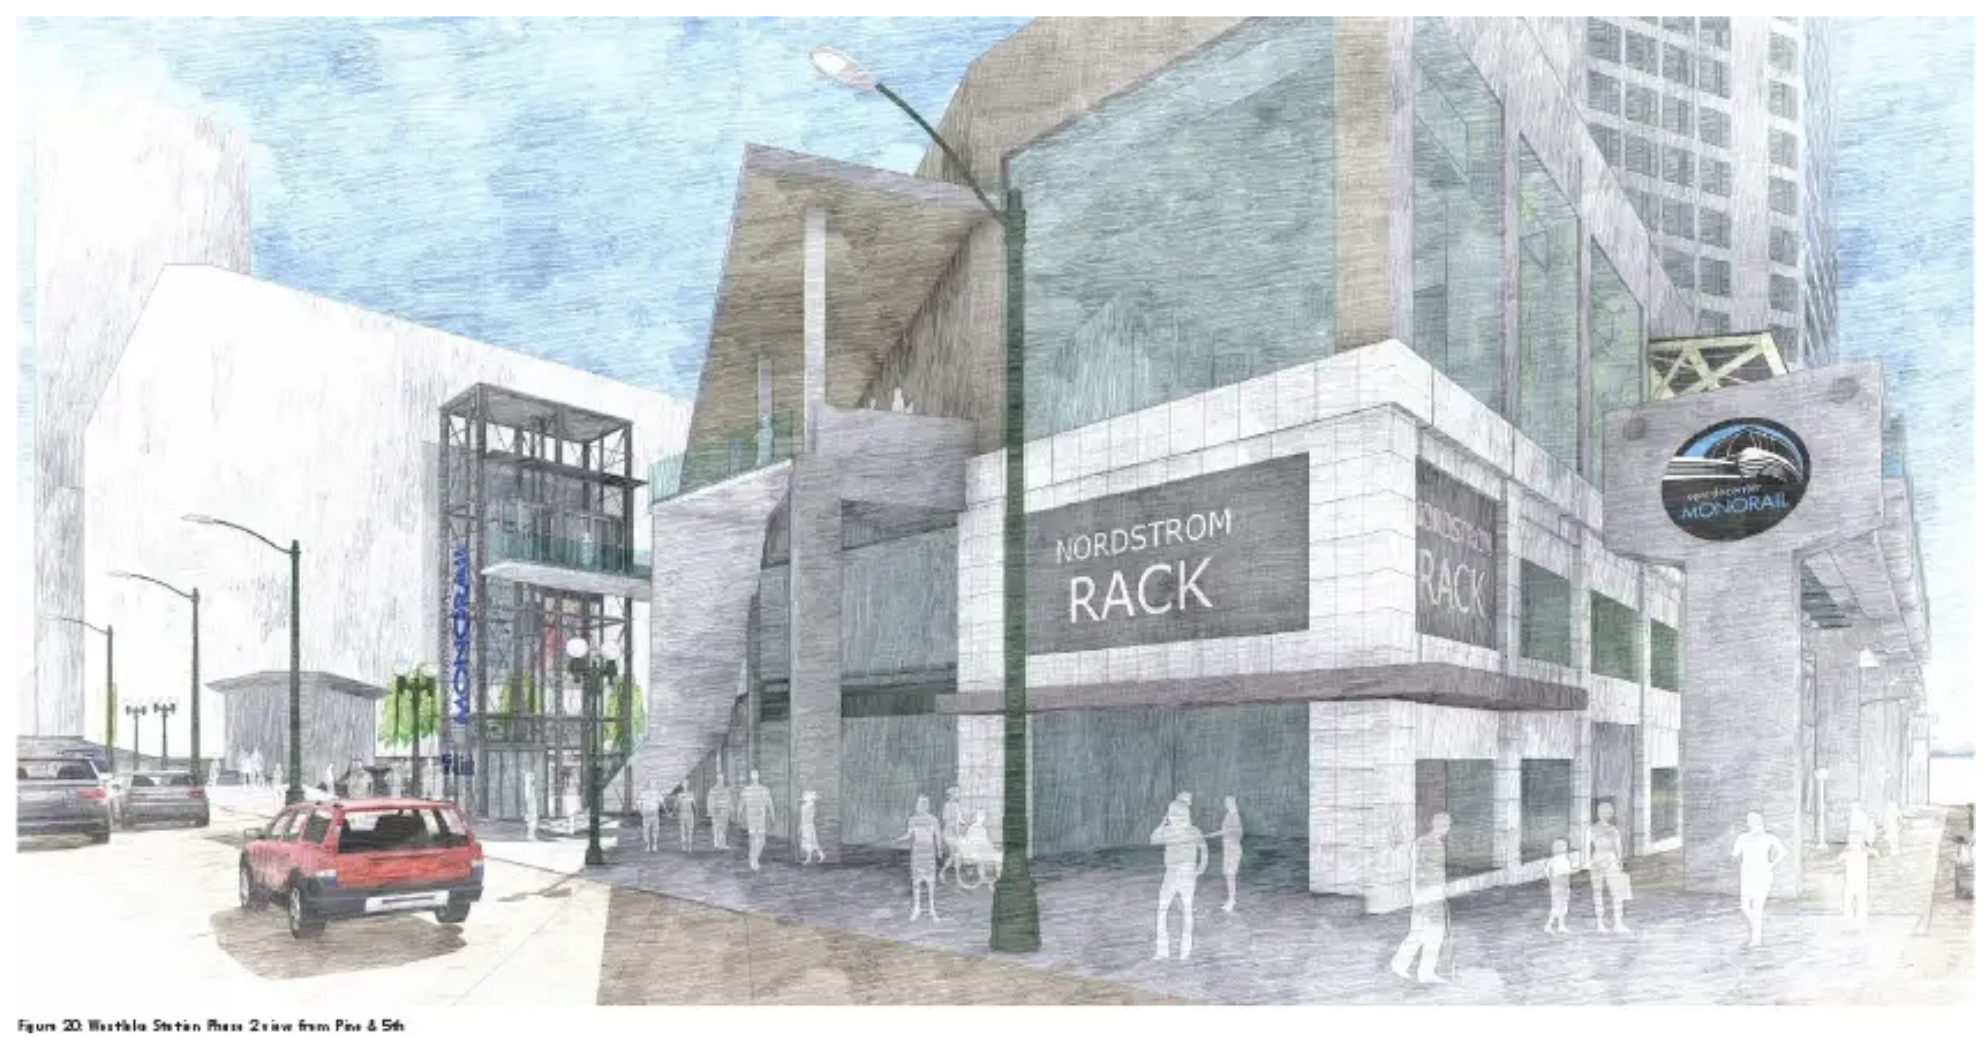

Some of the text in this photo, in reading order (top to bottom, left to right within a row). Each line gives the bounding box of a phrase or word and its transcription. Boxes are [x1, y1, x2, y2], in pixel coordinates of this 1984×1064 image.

[1055, 507, 1231, 563] NORDSTROM
[1682, 492, 1789, 521] MONORAIL
[1071, 555, 1213, 623] RACK
[1420, 548, 1486, 619] RACK
